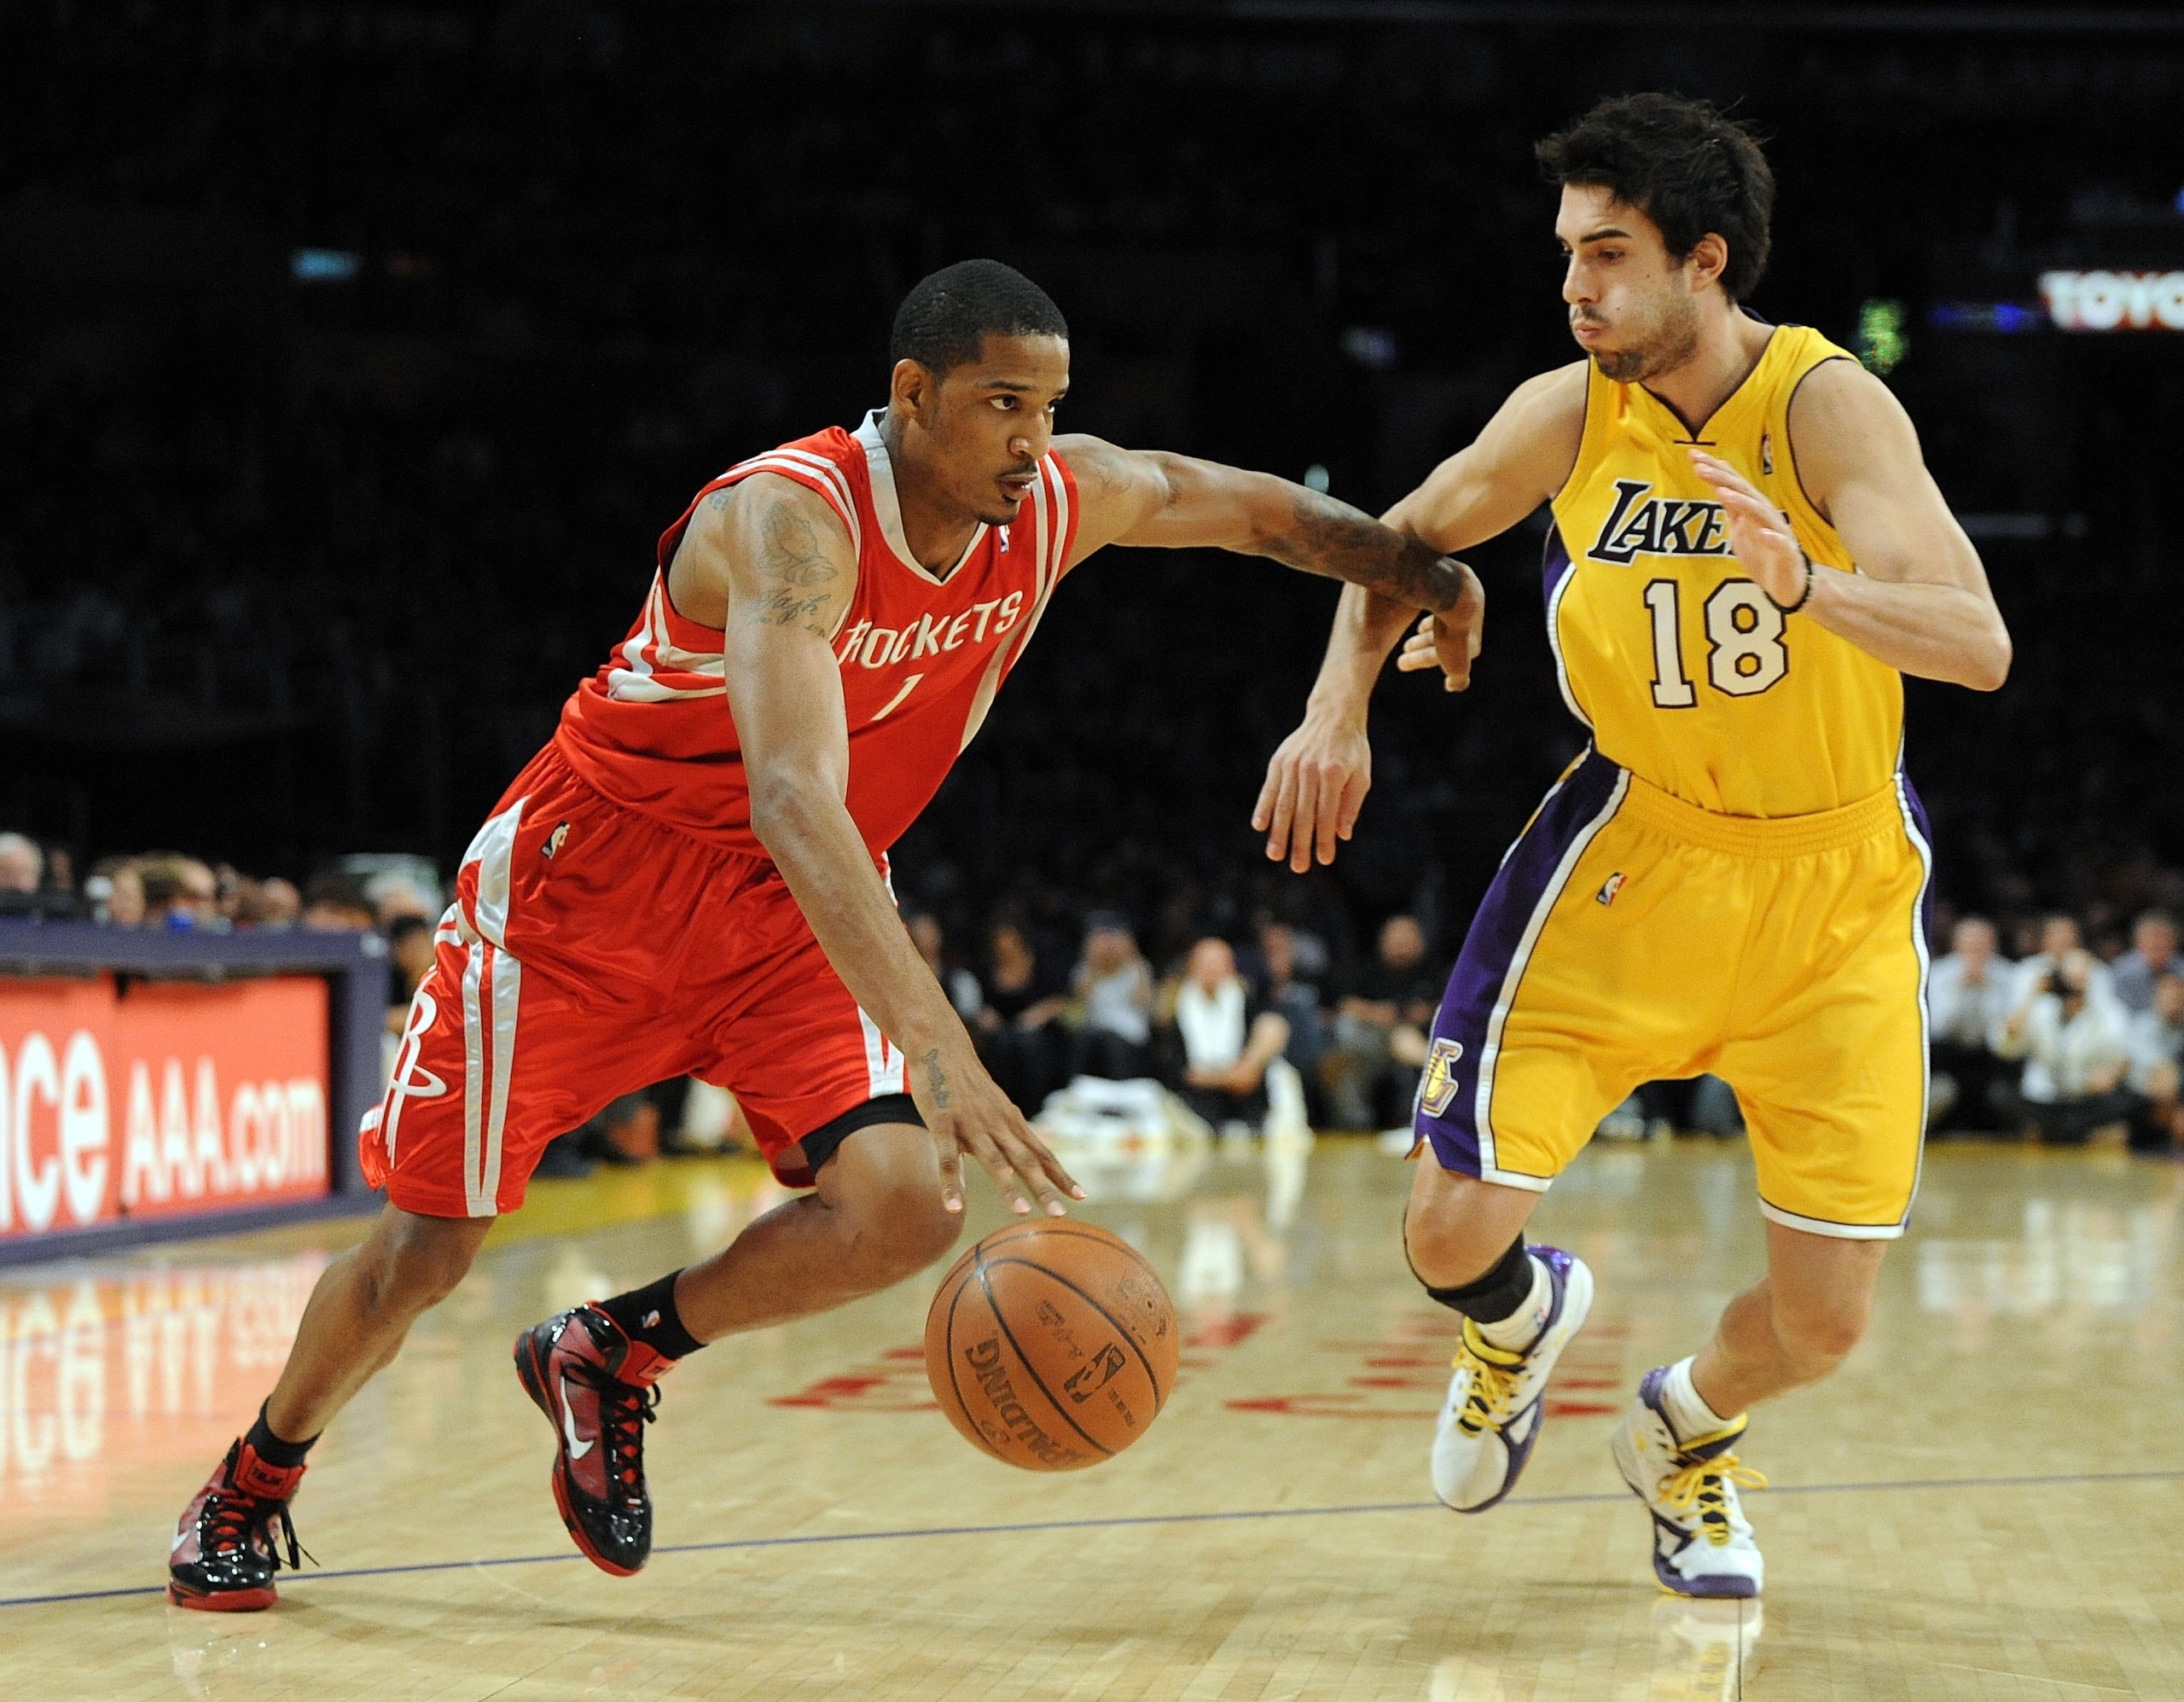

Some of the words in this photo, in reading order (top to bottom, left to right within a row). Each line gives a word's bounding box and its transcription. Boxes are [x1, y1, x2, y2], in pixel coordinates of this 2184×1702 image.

[1587, 478, 1789, 566] LAKE
[838, 590, 1024, 669] ROCKETS
[1643, 577, 1791, 709] 18
[870, 672, 924, 723] 1
[121, 1054, 327, 1203] AAA.com
